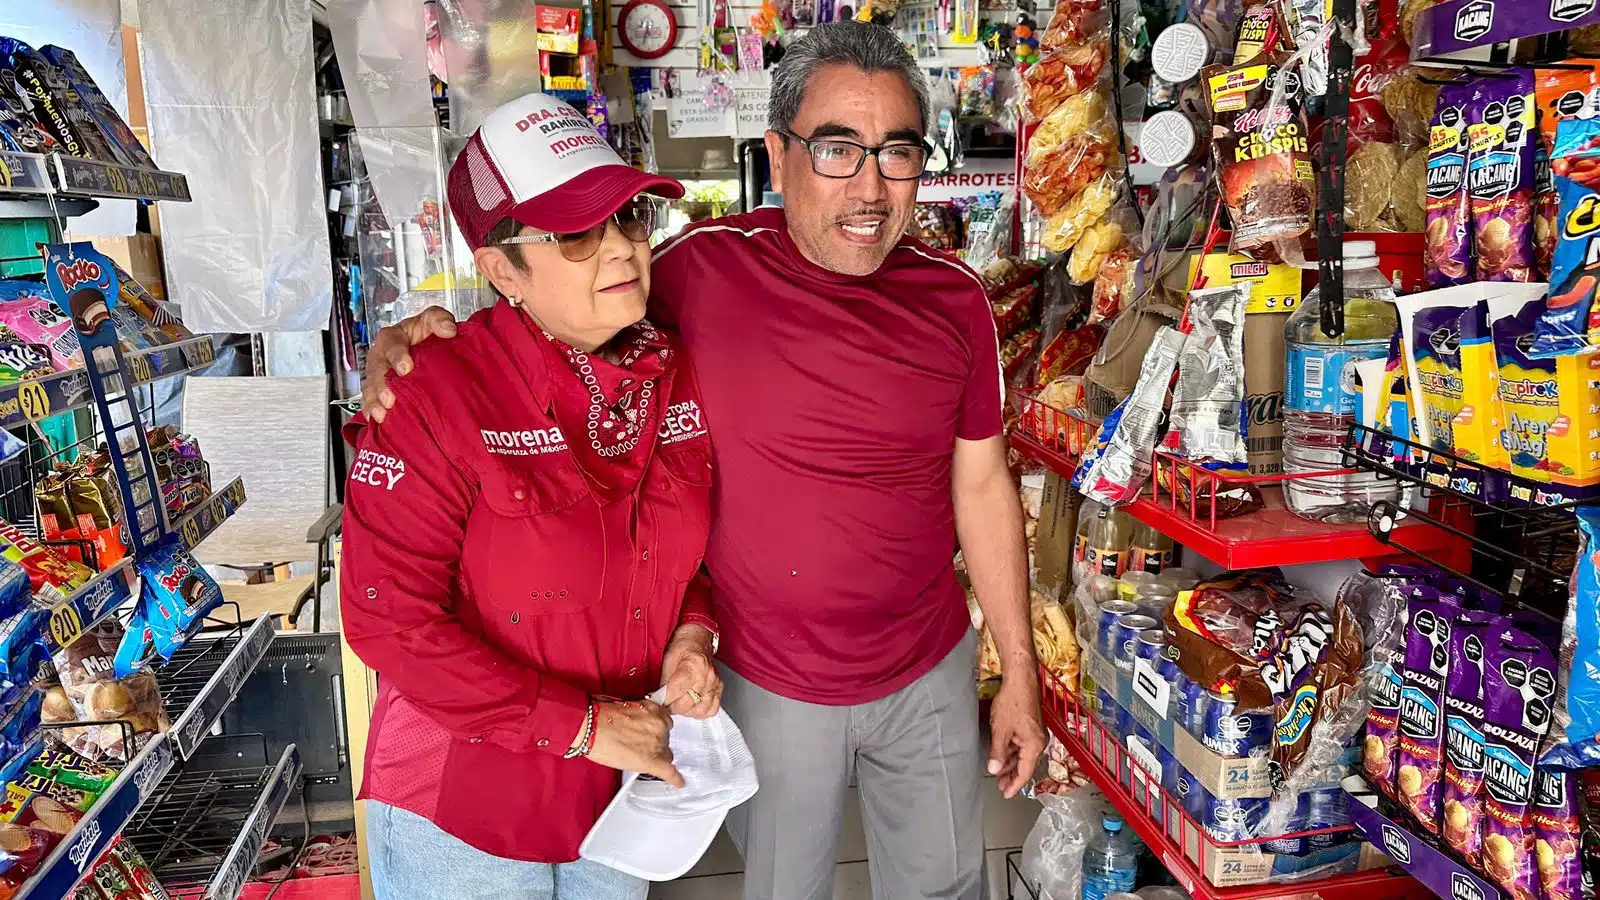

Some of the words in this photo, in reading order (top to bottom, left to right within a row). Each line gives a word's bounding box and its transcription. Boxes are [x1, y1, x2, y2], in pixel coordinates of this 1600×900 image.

[1457, 11, 1490, 33] KACANG
[515, 107, 558, 133] DRA.
[1234, 136, 1309, 164] KRISPIS
[1232, 263, 1268, 276] MILCH
[23, 385, 47, 418] $21
[657, 409, 702, 438] CECY
[480, 426, 565, 448] morena
[358, 448, 405, 472] DOCTORA
[351, 460, 406, 491] CECY
[54, 607, 78, 642] $20
[1202, 733, 1240, 756] JUMEX
[1484, 722, 1538, 751] BOLZAZA
[1227, 769, 1249, 785] 24
[1222, 862, 1242, 874] 24
